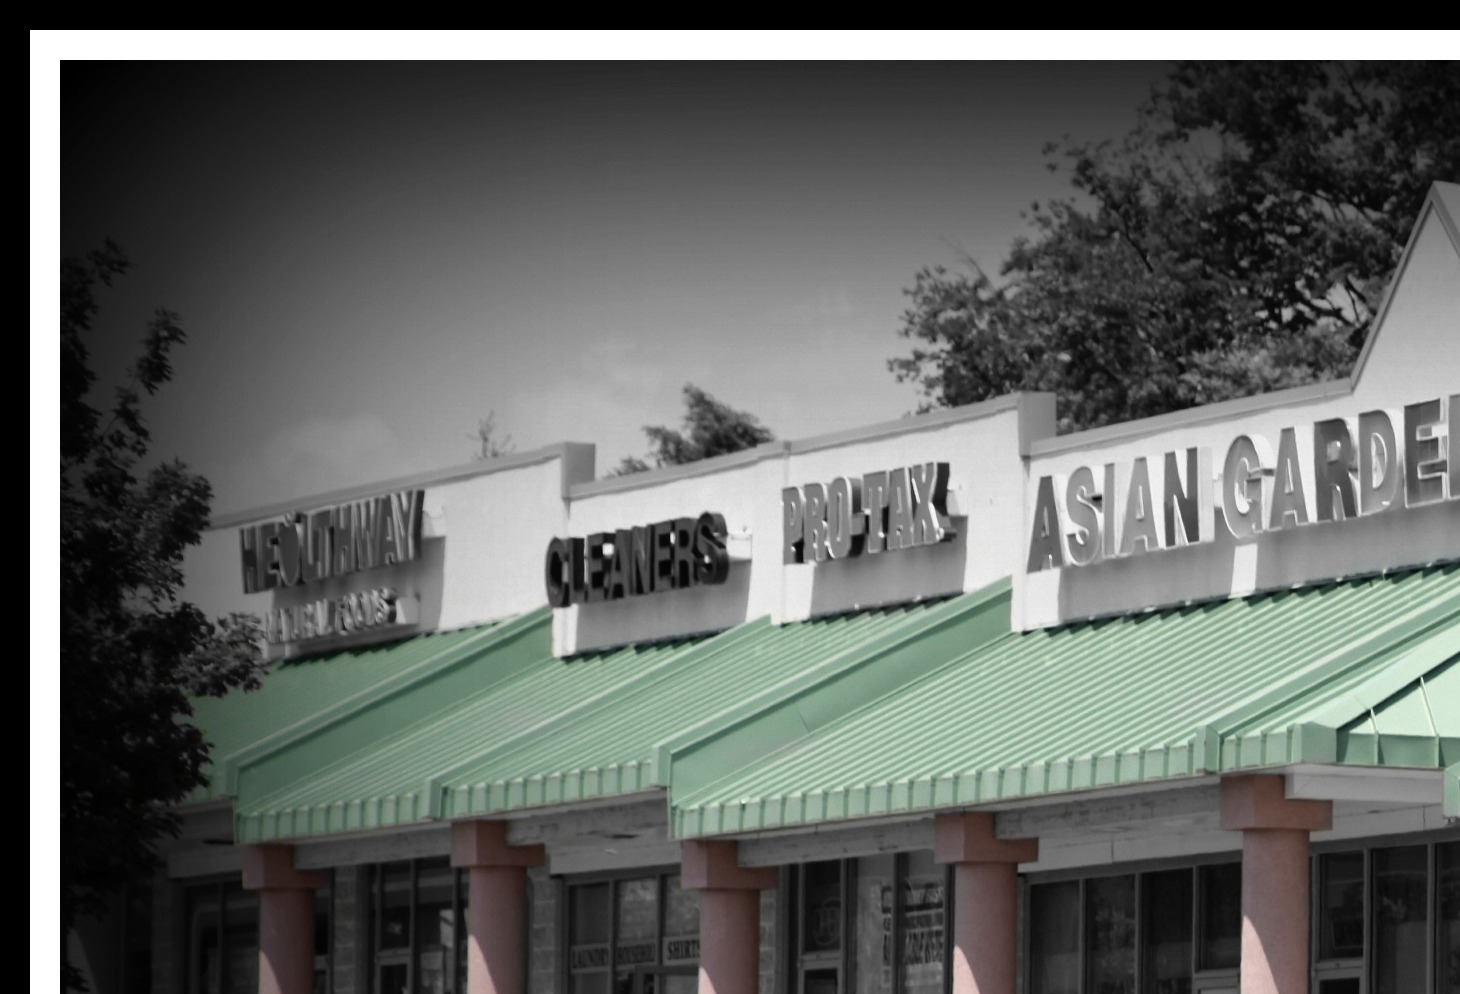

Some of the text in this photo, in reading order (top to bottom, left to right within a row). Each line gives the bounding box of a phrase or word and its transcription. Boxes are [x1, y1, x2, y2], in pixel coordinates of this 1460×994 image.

[545, 512, 729, 608] CLEANERS
[782, 462, 949, 565] PRO-TAX
[1027, 446, 1204, 573] ASIAN
